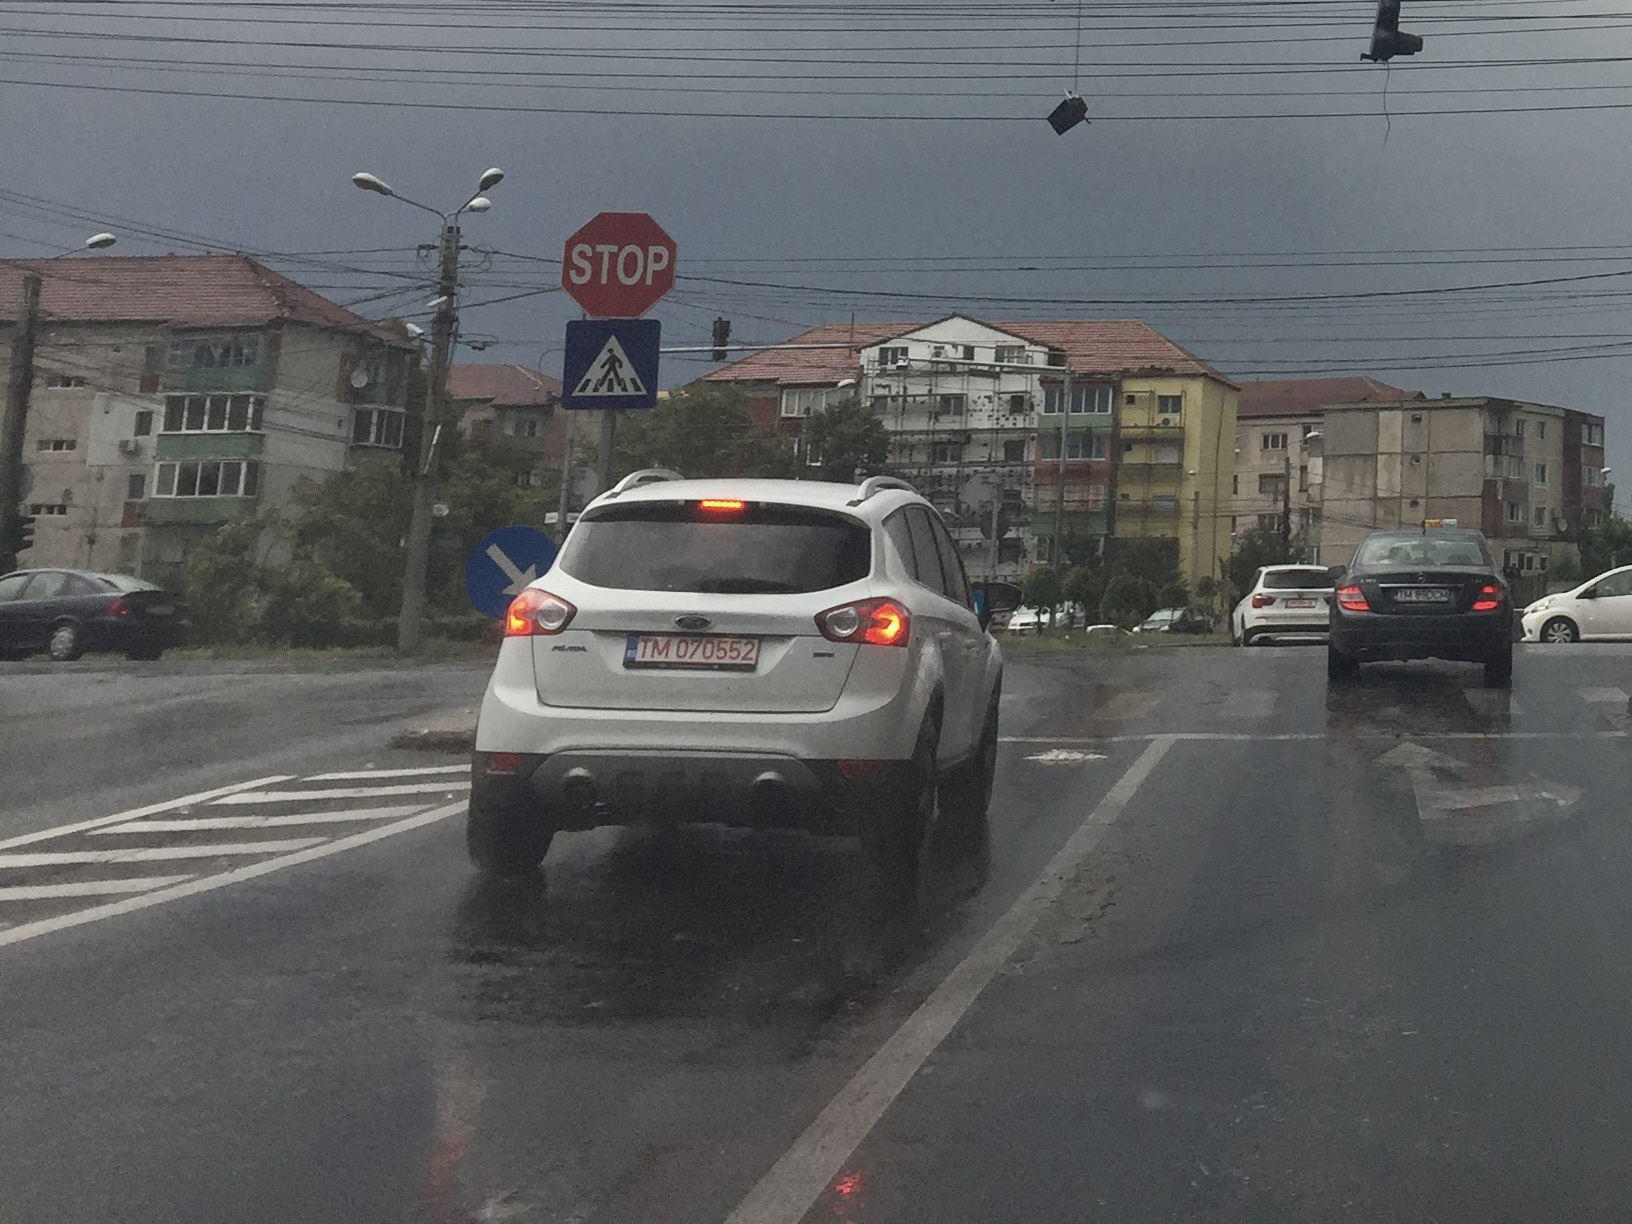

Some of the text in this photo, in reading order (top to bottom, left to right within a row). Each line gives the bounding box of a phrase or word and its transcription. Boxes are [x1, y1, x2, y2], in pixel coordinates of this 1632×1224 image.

[568, 243, 670, 287] STOP
[639, 635, 755, 661] TM 070552
